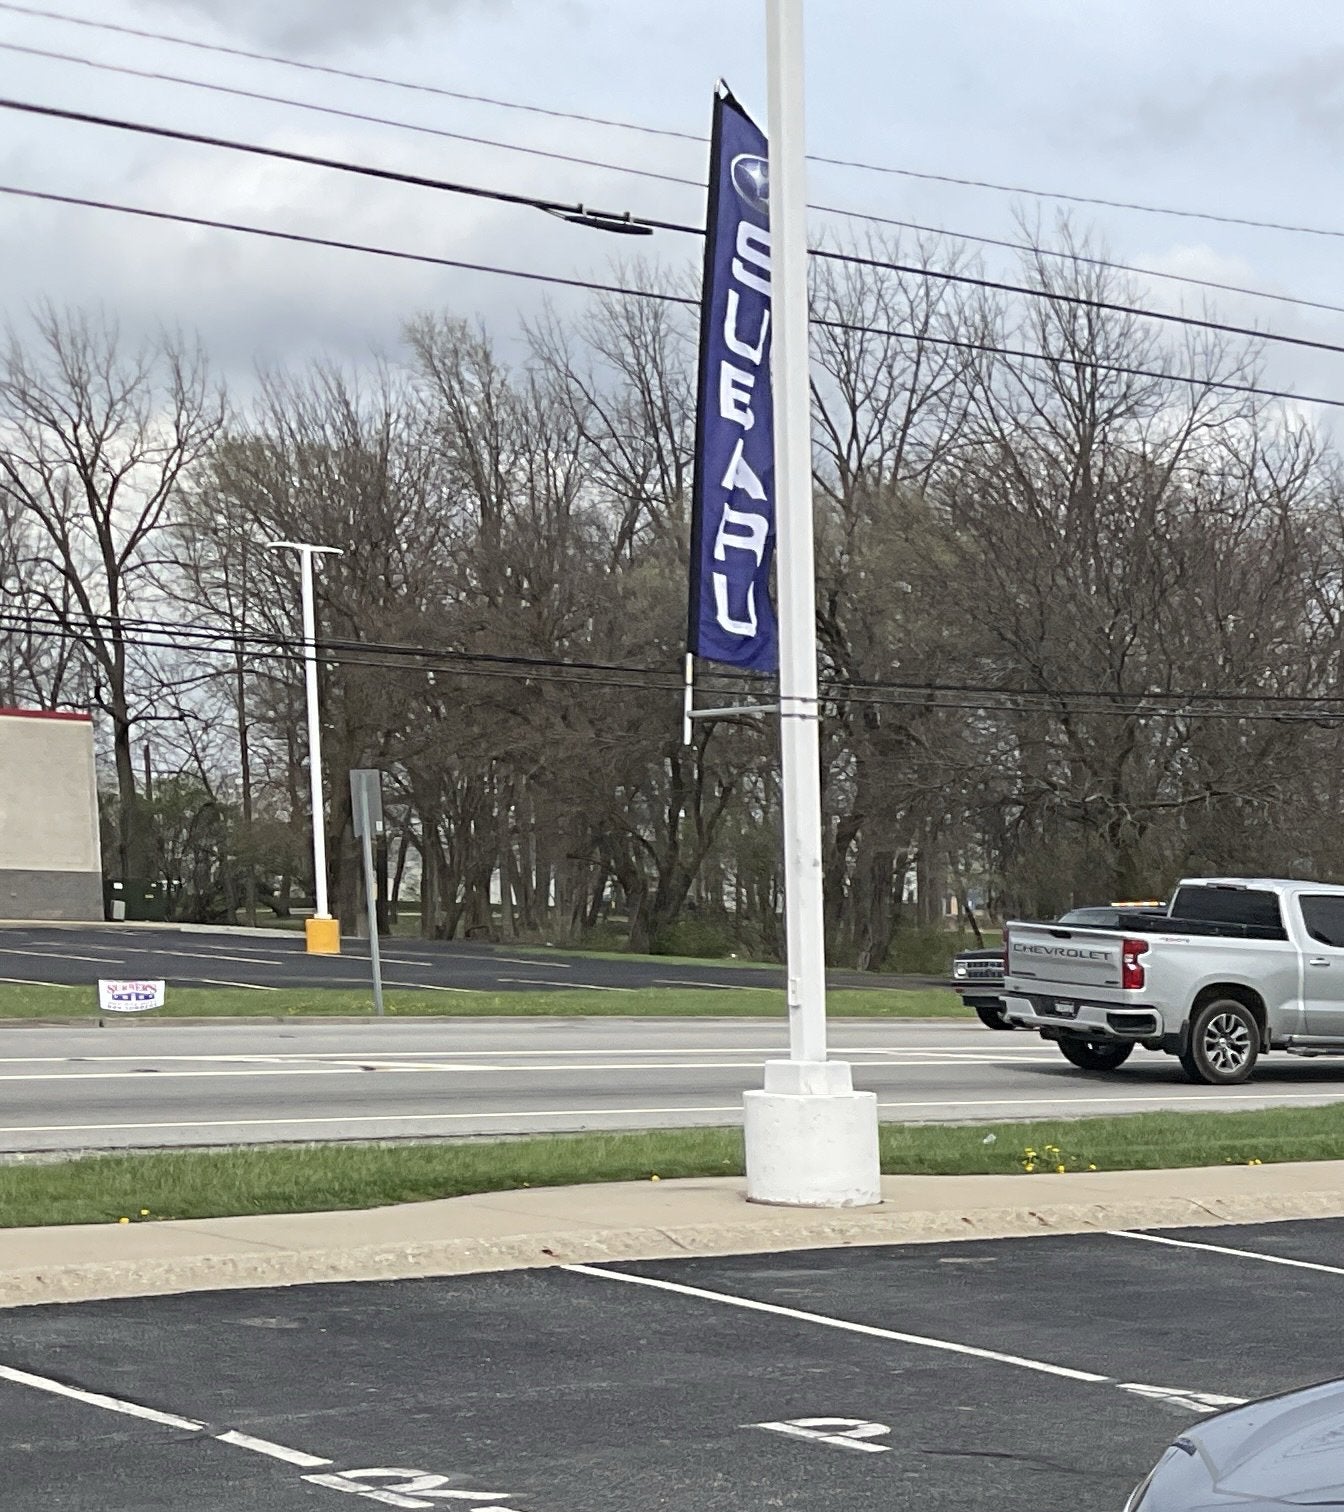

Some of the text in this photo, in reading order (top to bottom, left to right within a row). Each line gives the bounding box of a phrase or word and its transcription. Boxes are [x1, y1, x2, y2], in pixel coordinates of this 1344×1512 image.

[709, 219, 772, 638] SUBARU
[1013, 943, 1113, 960] CHEVROLET
[300, 1467, 512, 1509] R
